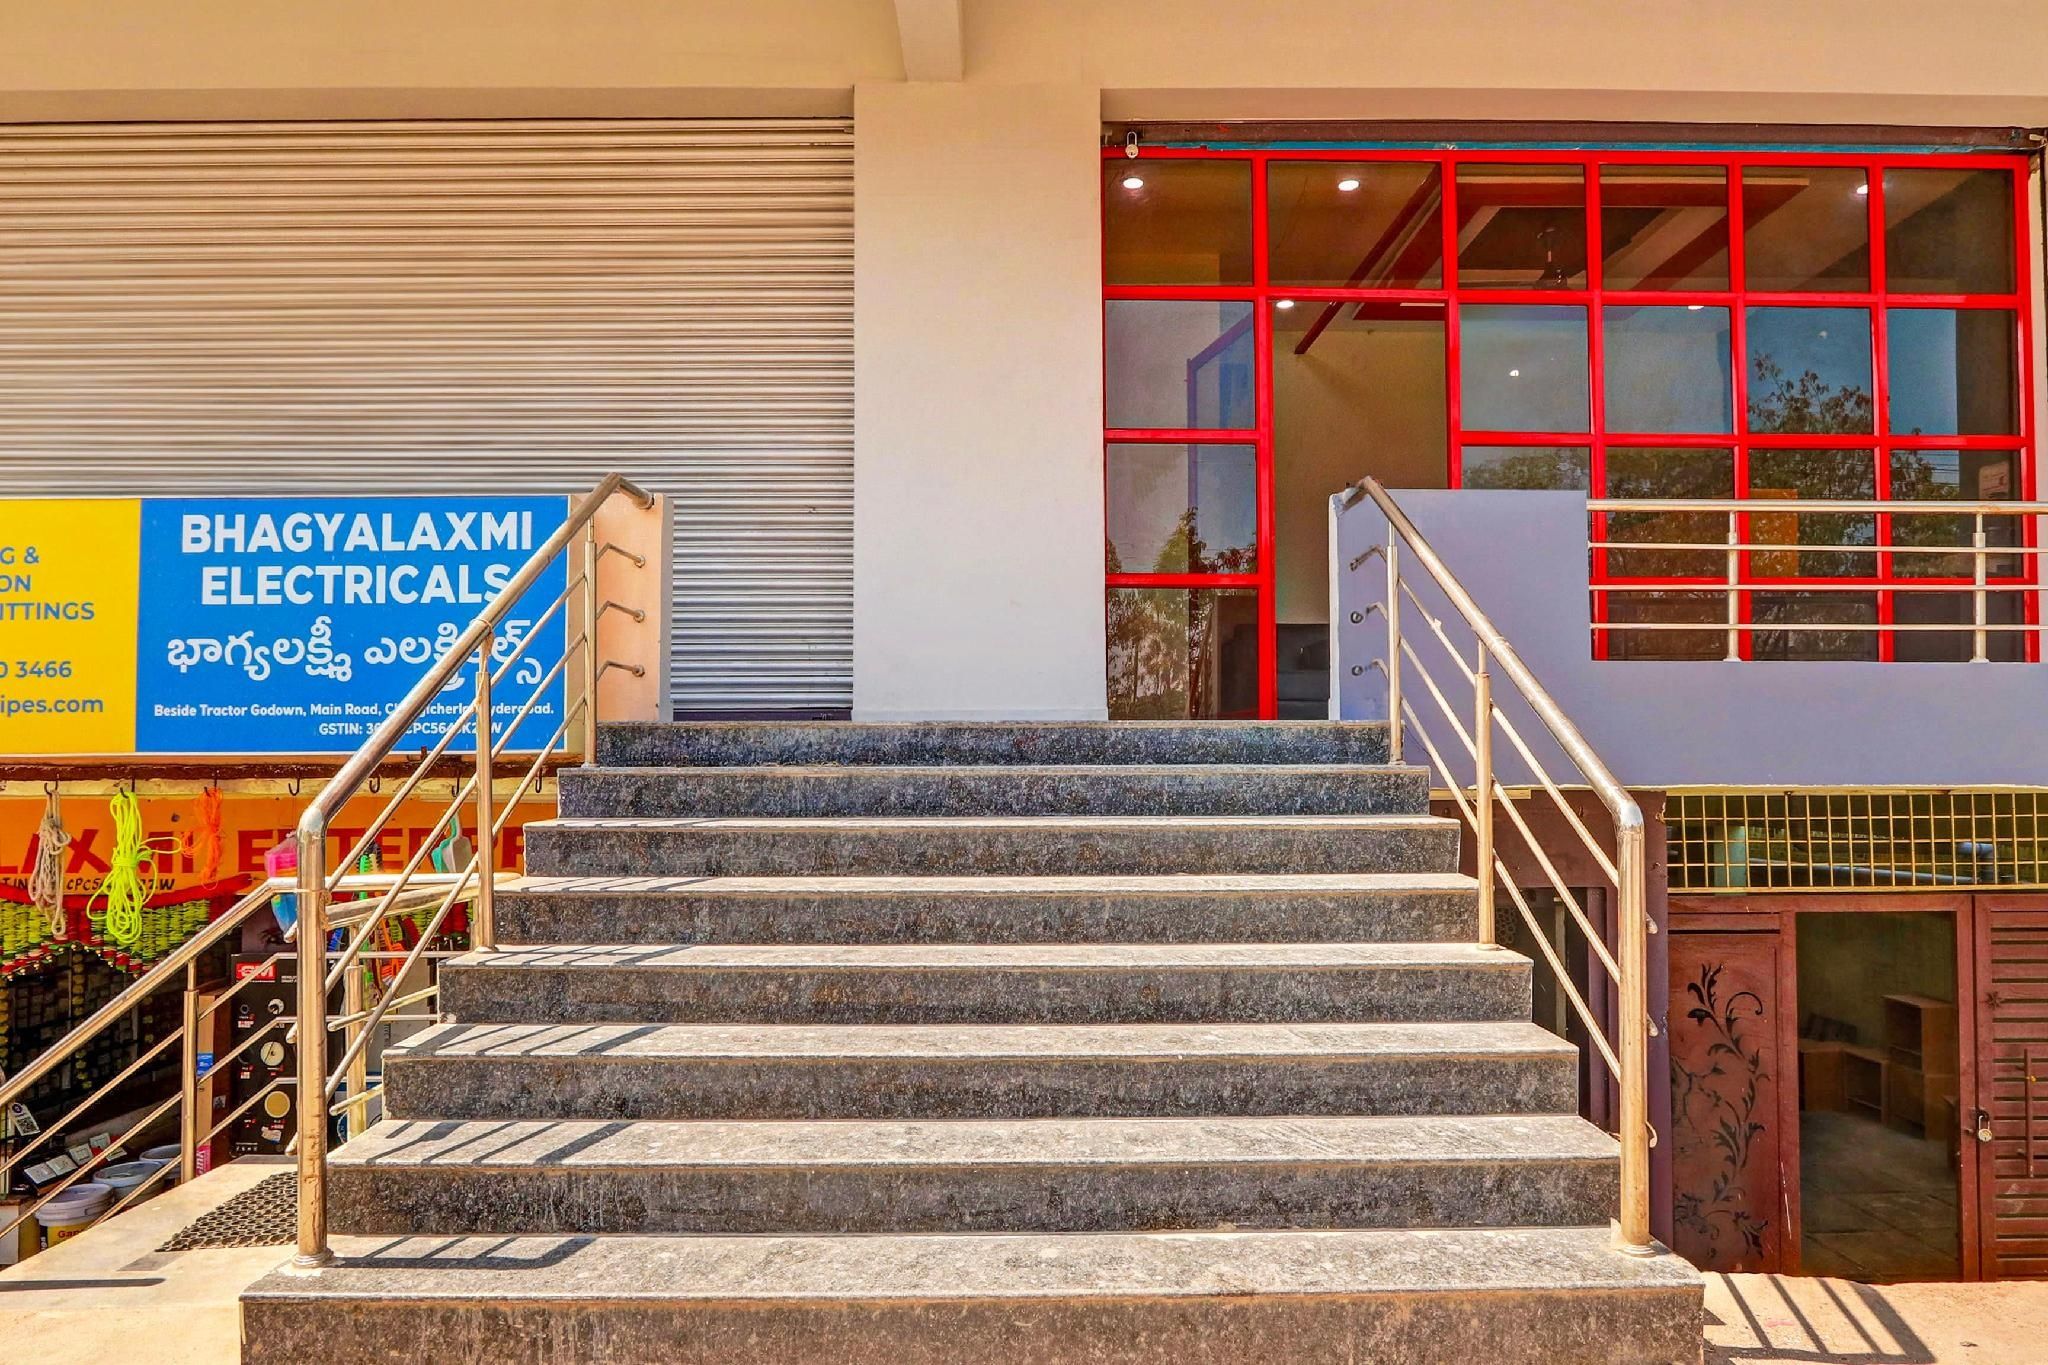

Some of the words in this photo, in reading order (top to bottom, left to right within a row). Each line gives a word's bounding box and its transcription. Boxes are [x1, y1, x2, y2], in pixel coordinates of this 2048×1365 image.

[182, 511, 533, 553] BHAGYALAXMI
[23, 546, 39, 564] &
[201, 564, 509, 605] ELECTRICALS
[15, 661, 72, 678] 3466
[154, 704, 197, 717] Beside
[200, 704, 248, 716] Tractor
[250, 703, 307, 717] Godown,
[310, 703, 342, 715] Main
[344, 703, 382, 716] Road,
[319, 722, 363, 735] GSTIN:
